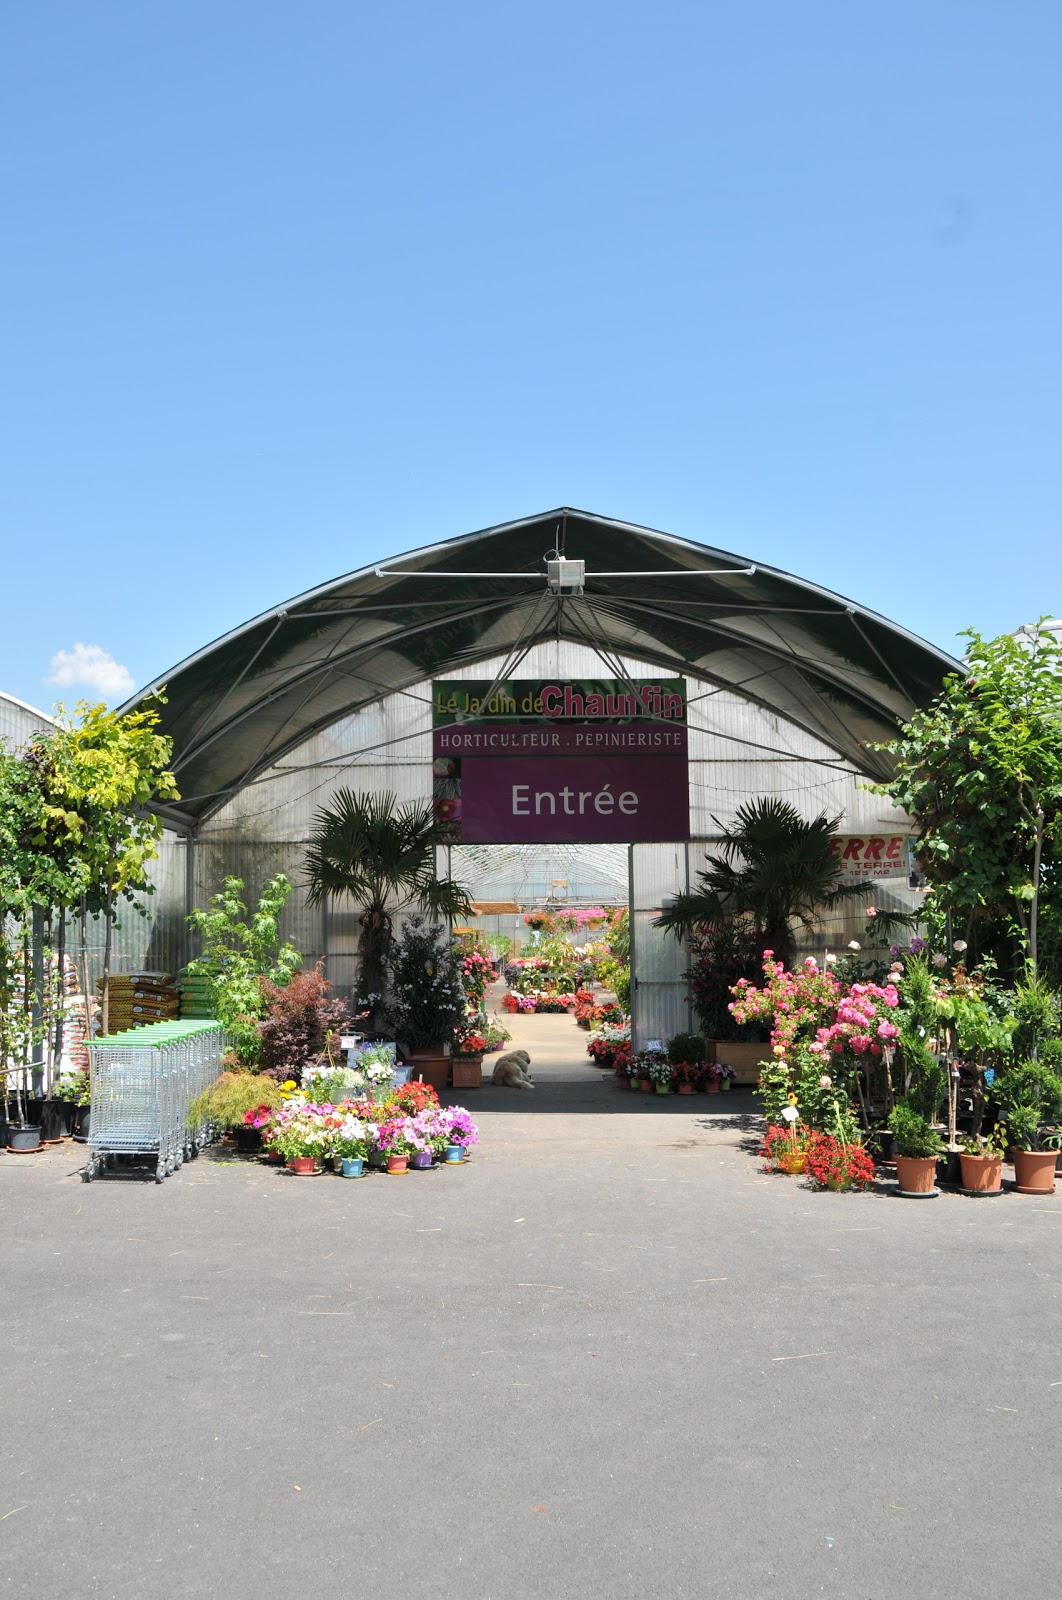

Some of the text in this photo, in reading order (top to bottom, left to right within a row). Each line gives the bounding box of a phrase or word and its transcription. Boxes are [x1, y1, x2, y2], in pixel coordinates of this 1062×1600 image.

[437, 693, 457, 714] Le
[527, 691, 544, 714] de
[540, 685, 683, 718] Chauffin
[440, 733, 560, 747] HORTICULTEUR
[576, 732, 682, 746] PEPINIERISTE
[512, 784, 639, 816] Entrée
[855, 861, 906, 869] TERRE!
